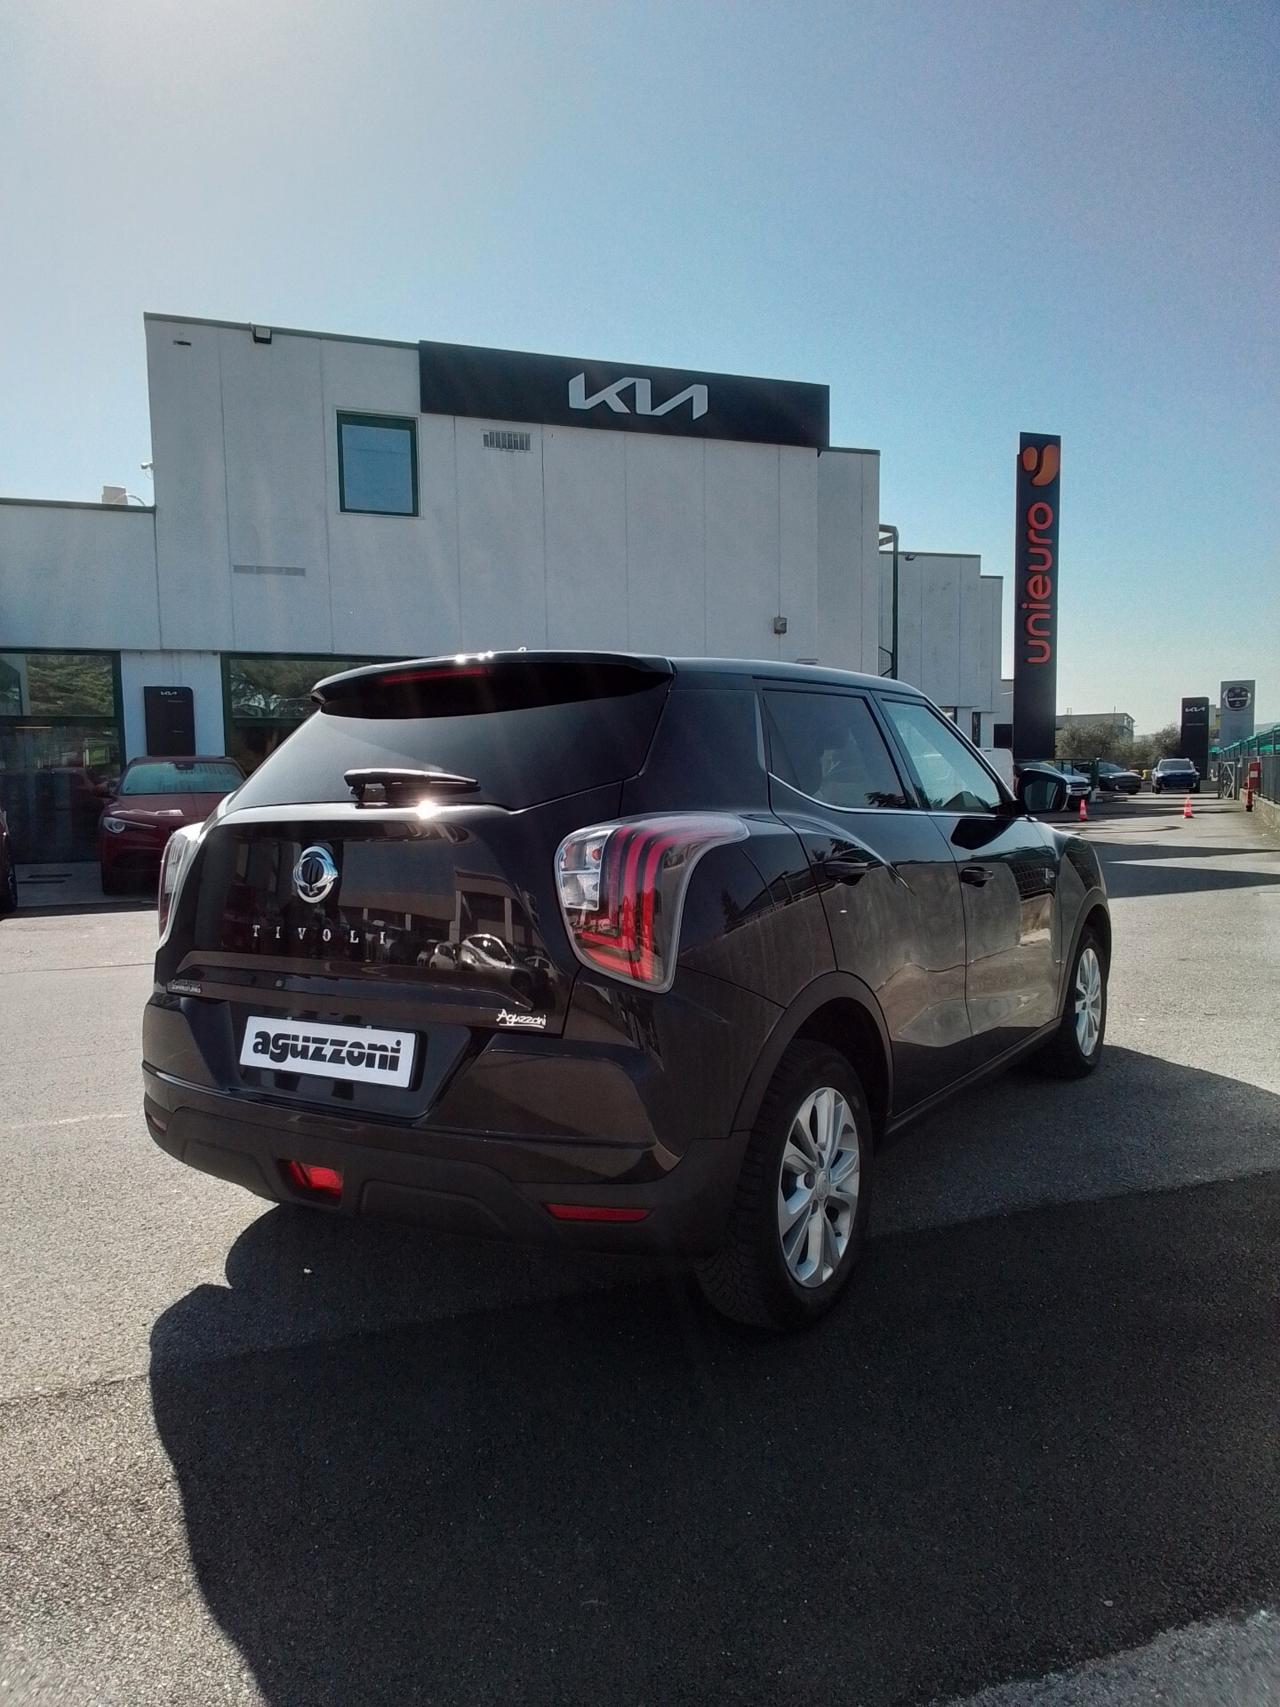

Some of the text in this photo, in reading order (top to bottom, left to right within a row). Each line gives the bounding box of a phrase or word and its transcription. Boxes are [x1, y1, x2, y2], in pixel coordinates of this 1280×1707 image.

[568, 372, 708, 421] KIA
[1021, 501, 1054, 663] unieuro
[252, 924, 386, 945] TIVOLI
[252, 1030, 402, 1072] aguzzoni
